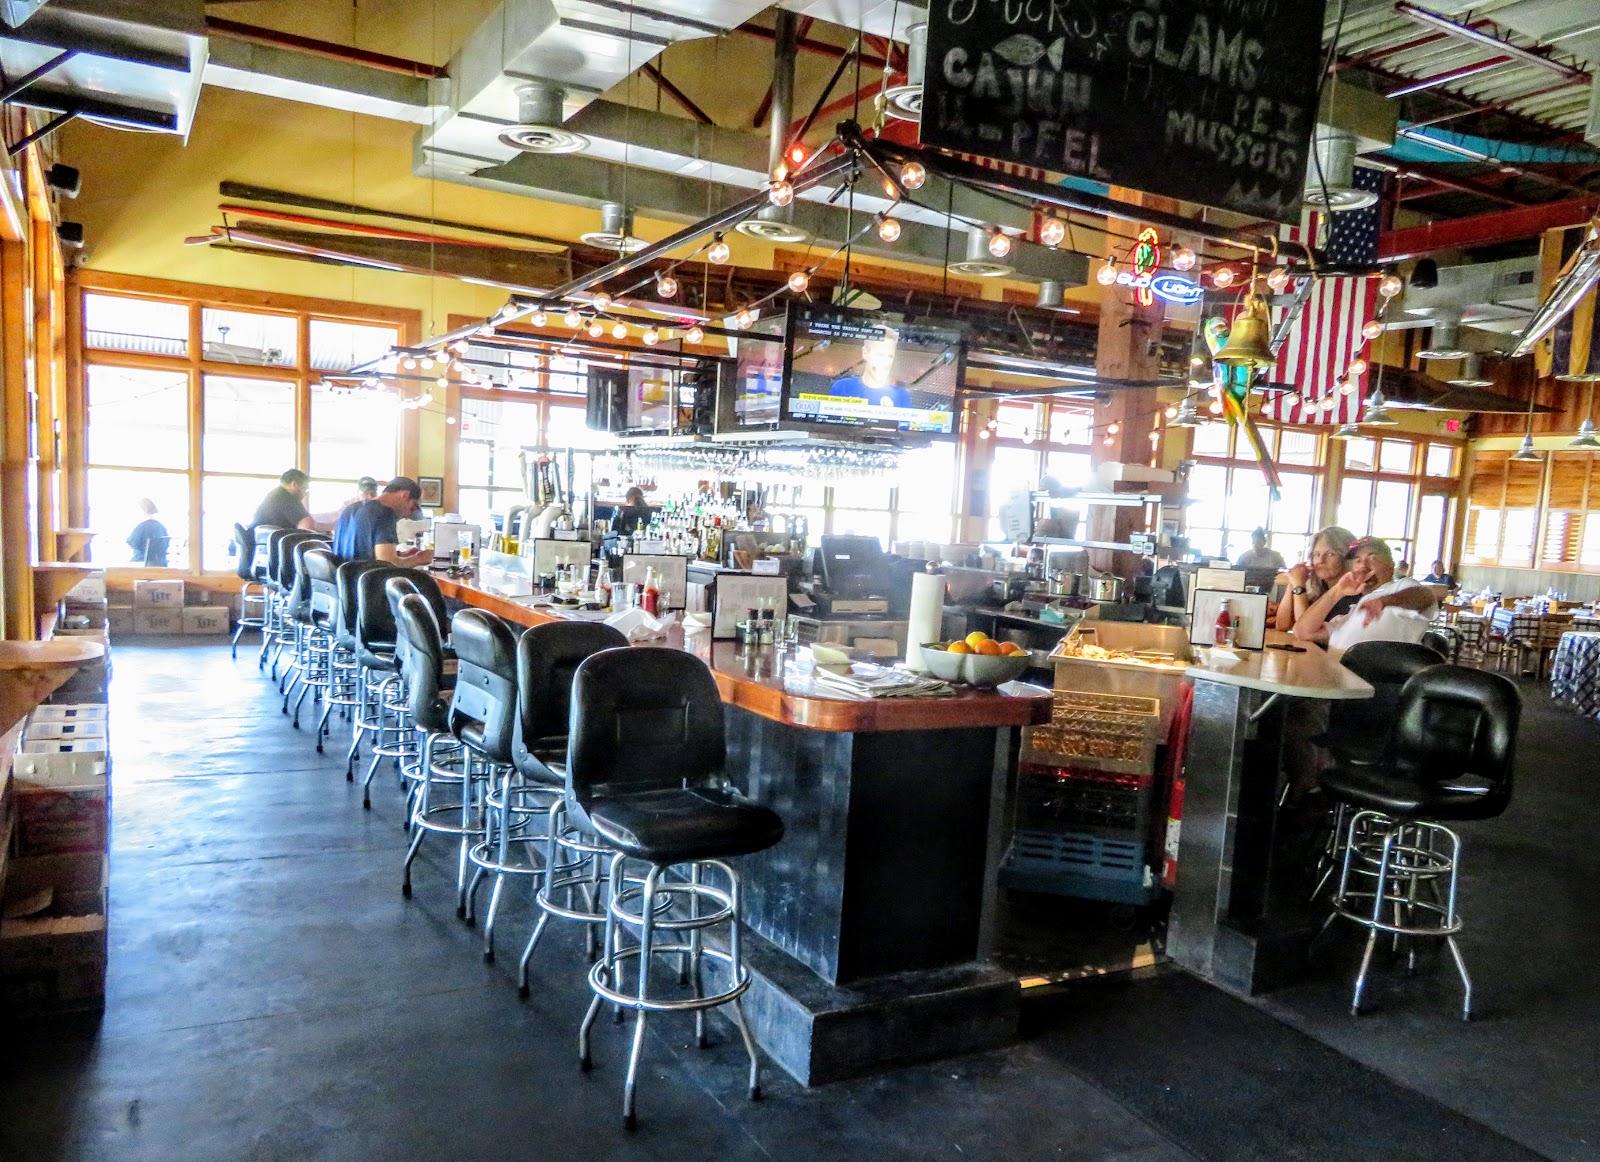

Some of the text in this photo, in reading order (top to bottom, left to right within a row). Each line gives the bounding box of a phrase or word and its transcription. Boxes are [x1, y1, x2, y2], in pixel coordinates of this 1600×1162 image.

[1127, 10, 1264, 90] CLAMS
[1162, 281, 1205, 297] LIGHT
[146, 588, 171, 601] Lite
